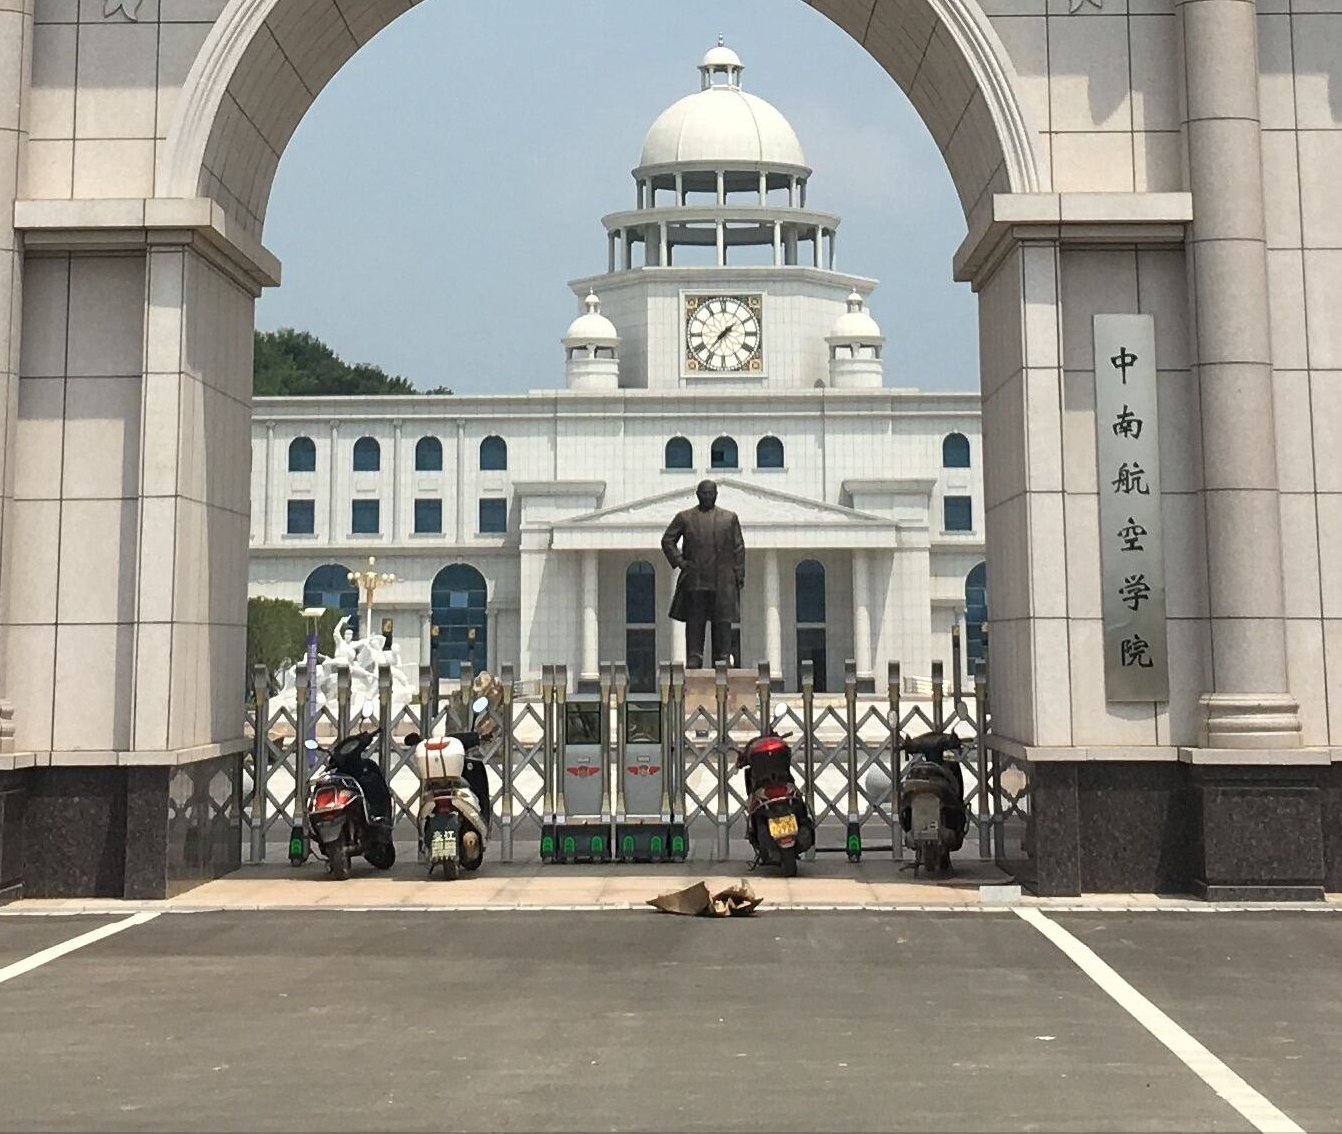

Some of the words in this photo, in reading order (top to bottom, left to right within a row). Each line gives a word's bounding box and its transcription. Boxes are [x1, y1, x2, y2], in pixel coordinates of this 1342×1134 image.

[1110, 347, 1155, 669] 中南航空学院
